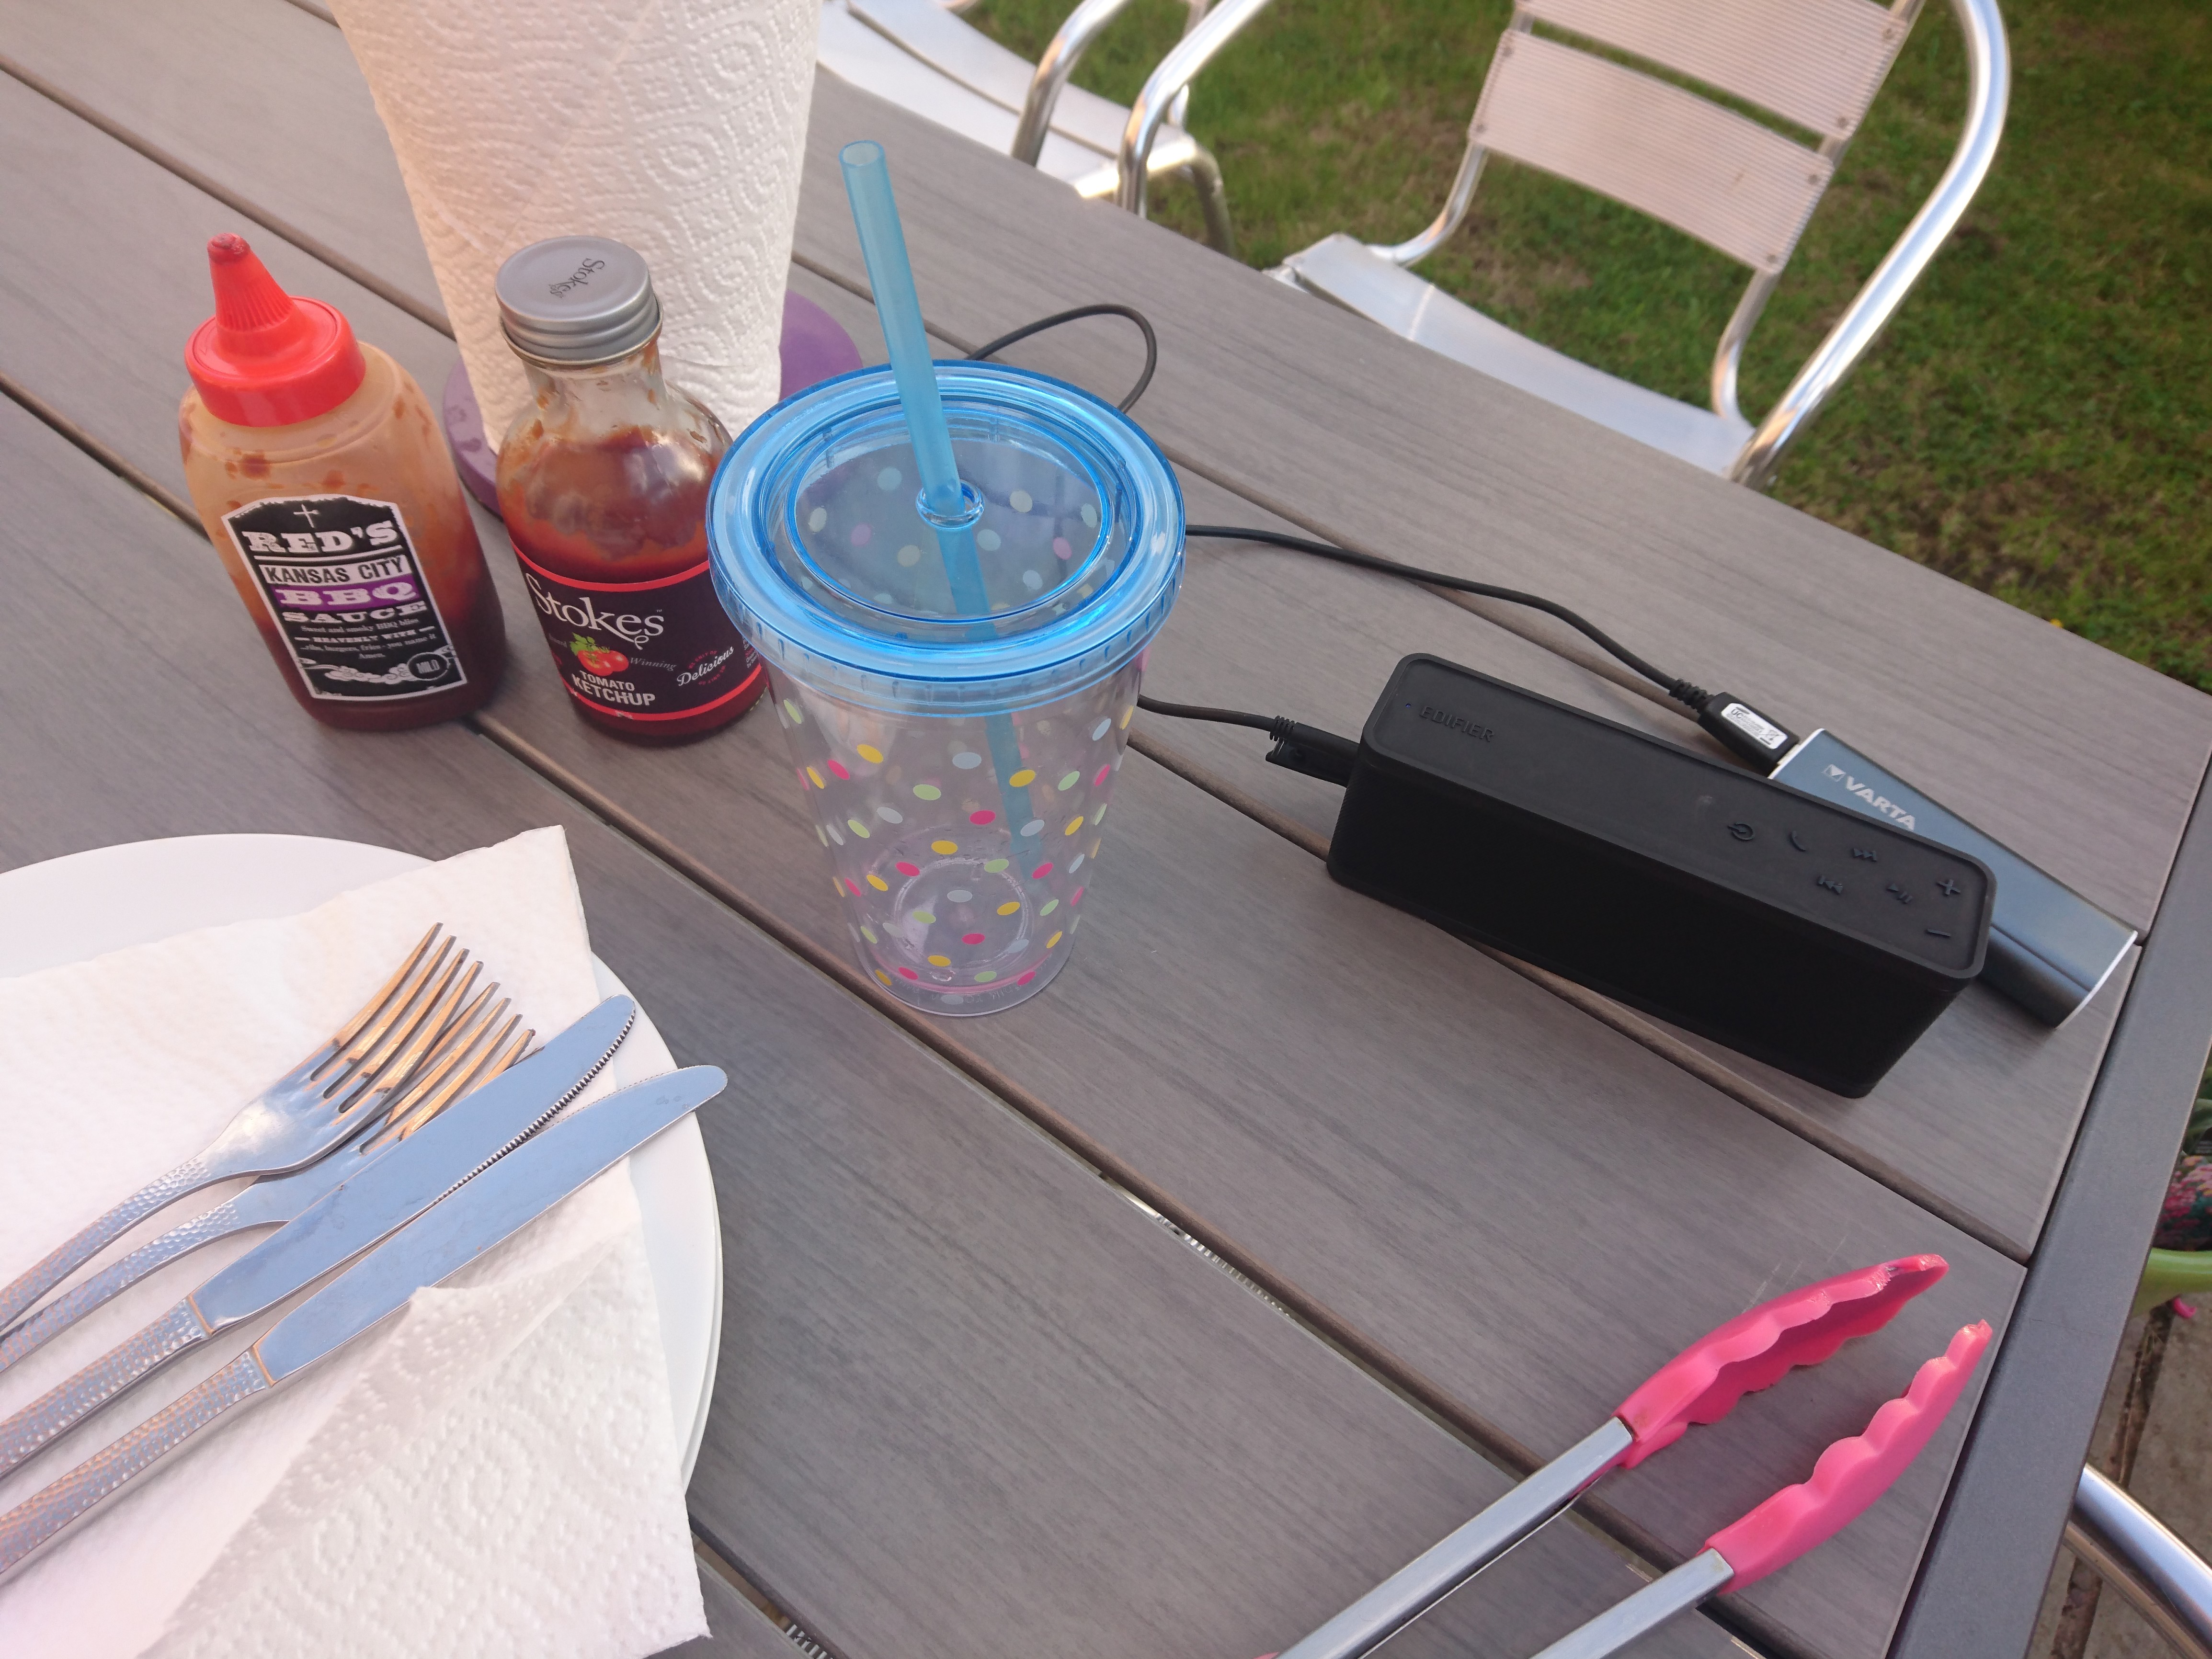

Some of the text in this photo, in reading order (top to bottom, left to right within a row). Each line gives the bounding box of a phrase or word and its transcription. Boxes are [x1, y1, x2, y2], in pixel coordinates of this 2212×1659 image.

[548, 258, 605, 298] Stokes
[242, 520, 398, 553] RED'S
[265, 556, 405, 584] KANSAS CITY
[275, 581, 417, 605] BBQ
[282, 601, 428, 624] SAUCE
[525, 573, 664, 650] Stokes
[579, 670, 635, 691] TOMATO
[630, 657, 677, 671] Winning
[676, 646, 734, 686] Delicious
[571, 673, 656, 706] KETCHUP
[1419, 705, 1495, 742] EDIFIER
[1846, 775, 1916, 832] VARTA
